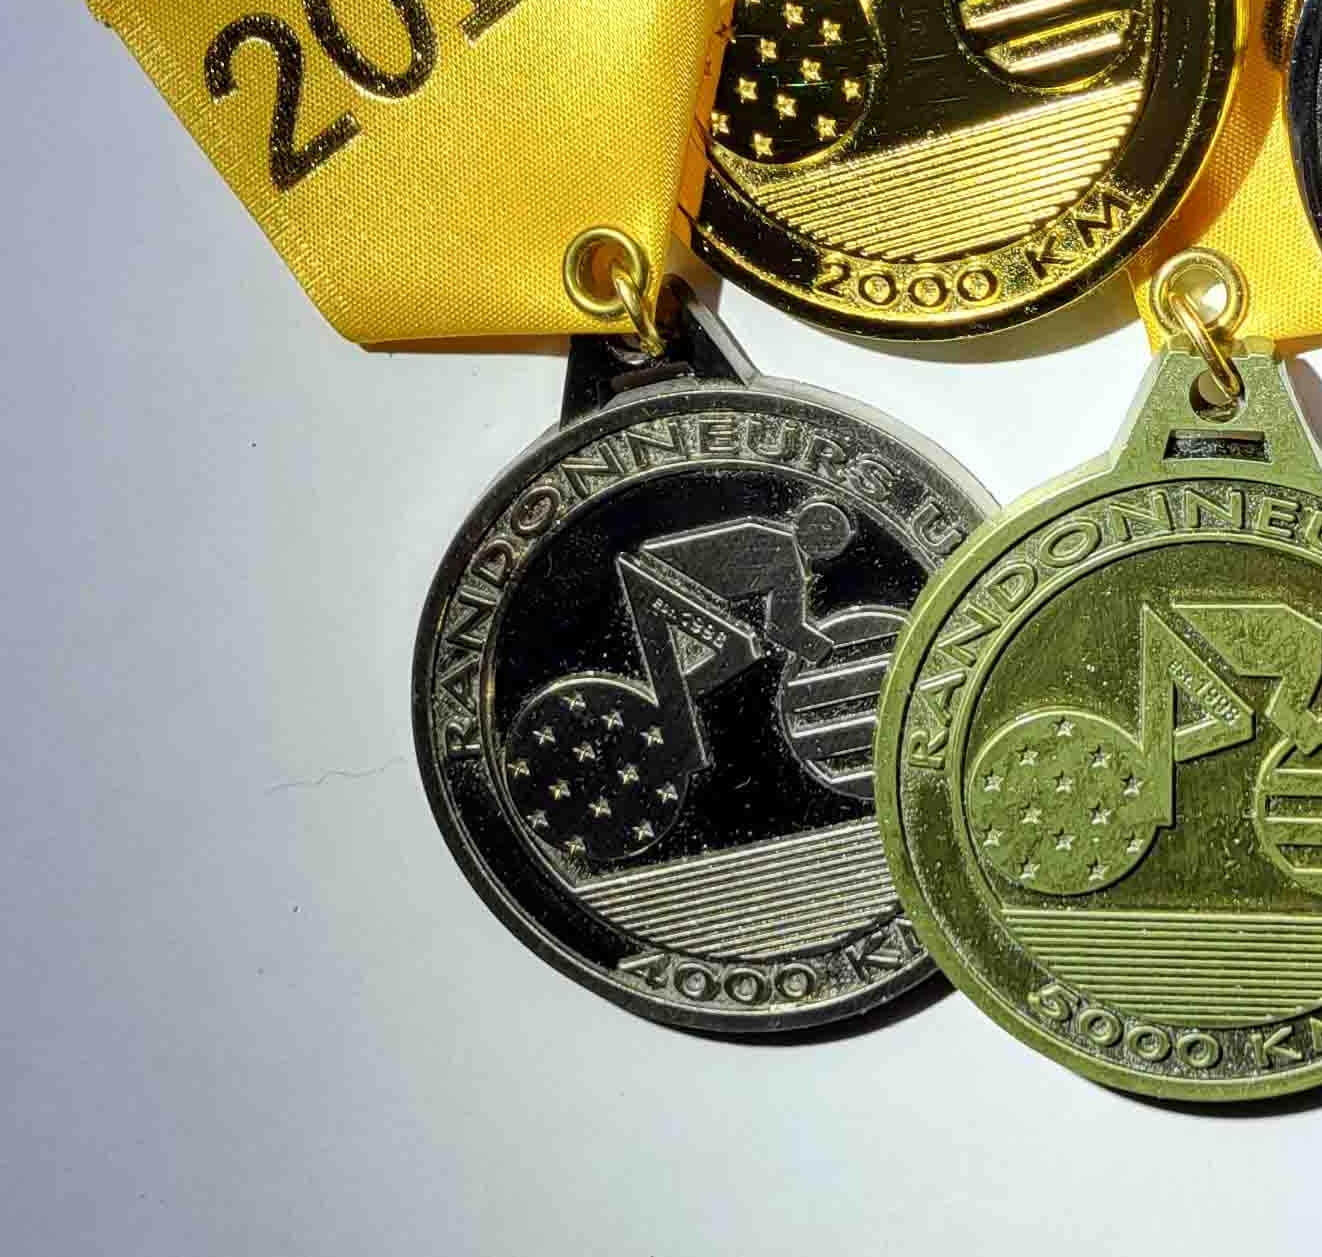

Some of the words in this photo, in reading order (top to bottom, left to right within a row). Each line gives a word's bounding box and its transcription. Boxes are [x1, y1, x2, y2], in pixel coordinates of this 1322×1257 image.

[816, 256, 999, 311] 2000
[1027, 180, 1140, 281] KM
[440, 412, 900, 762] RANDONNEURS
[616, 952, 817, 1005] 4000
[1027, 980, 1224, 1071] 5000
